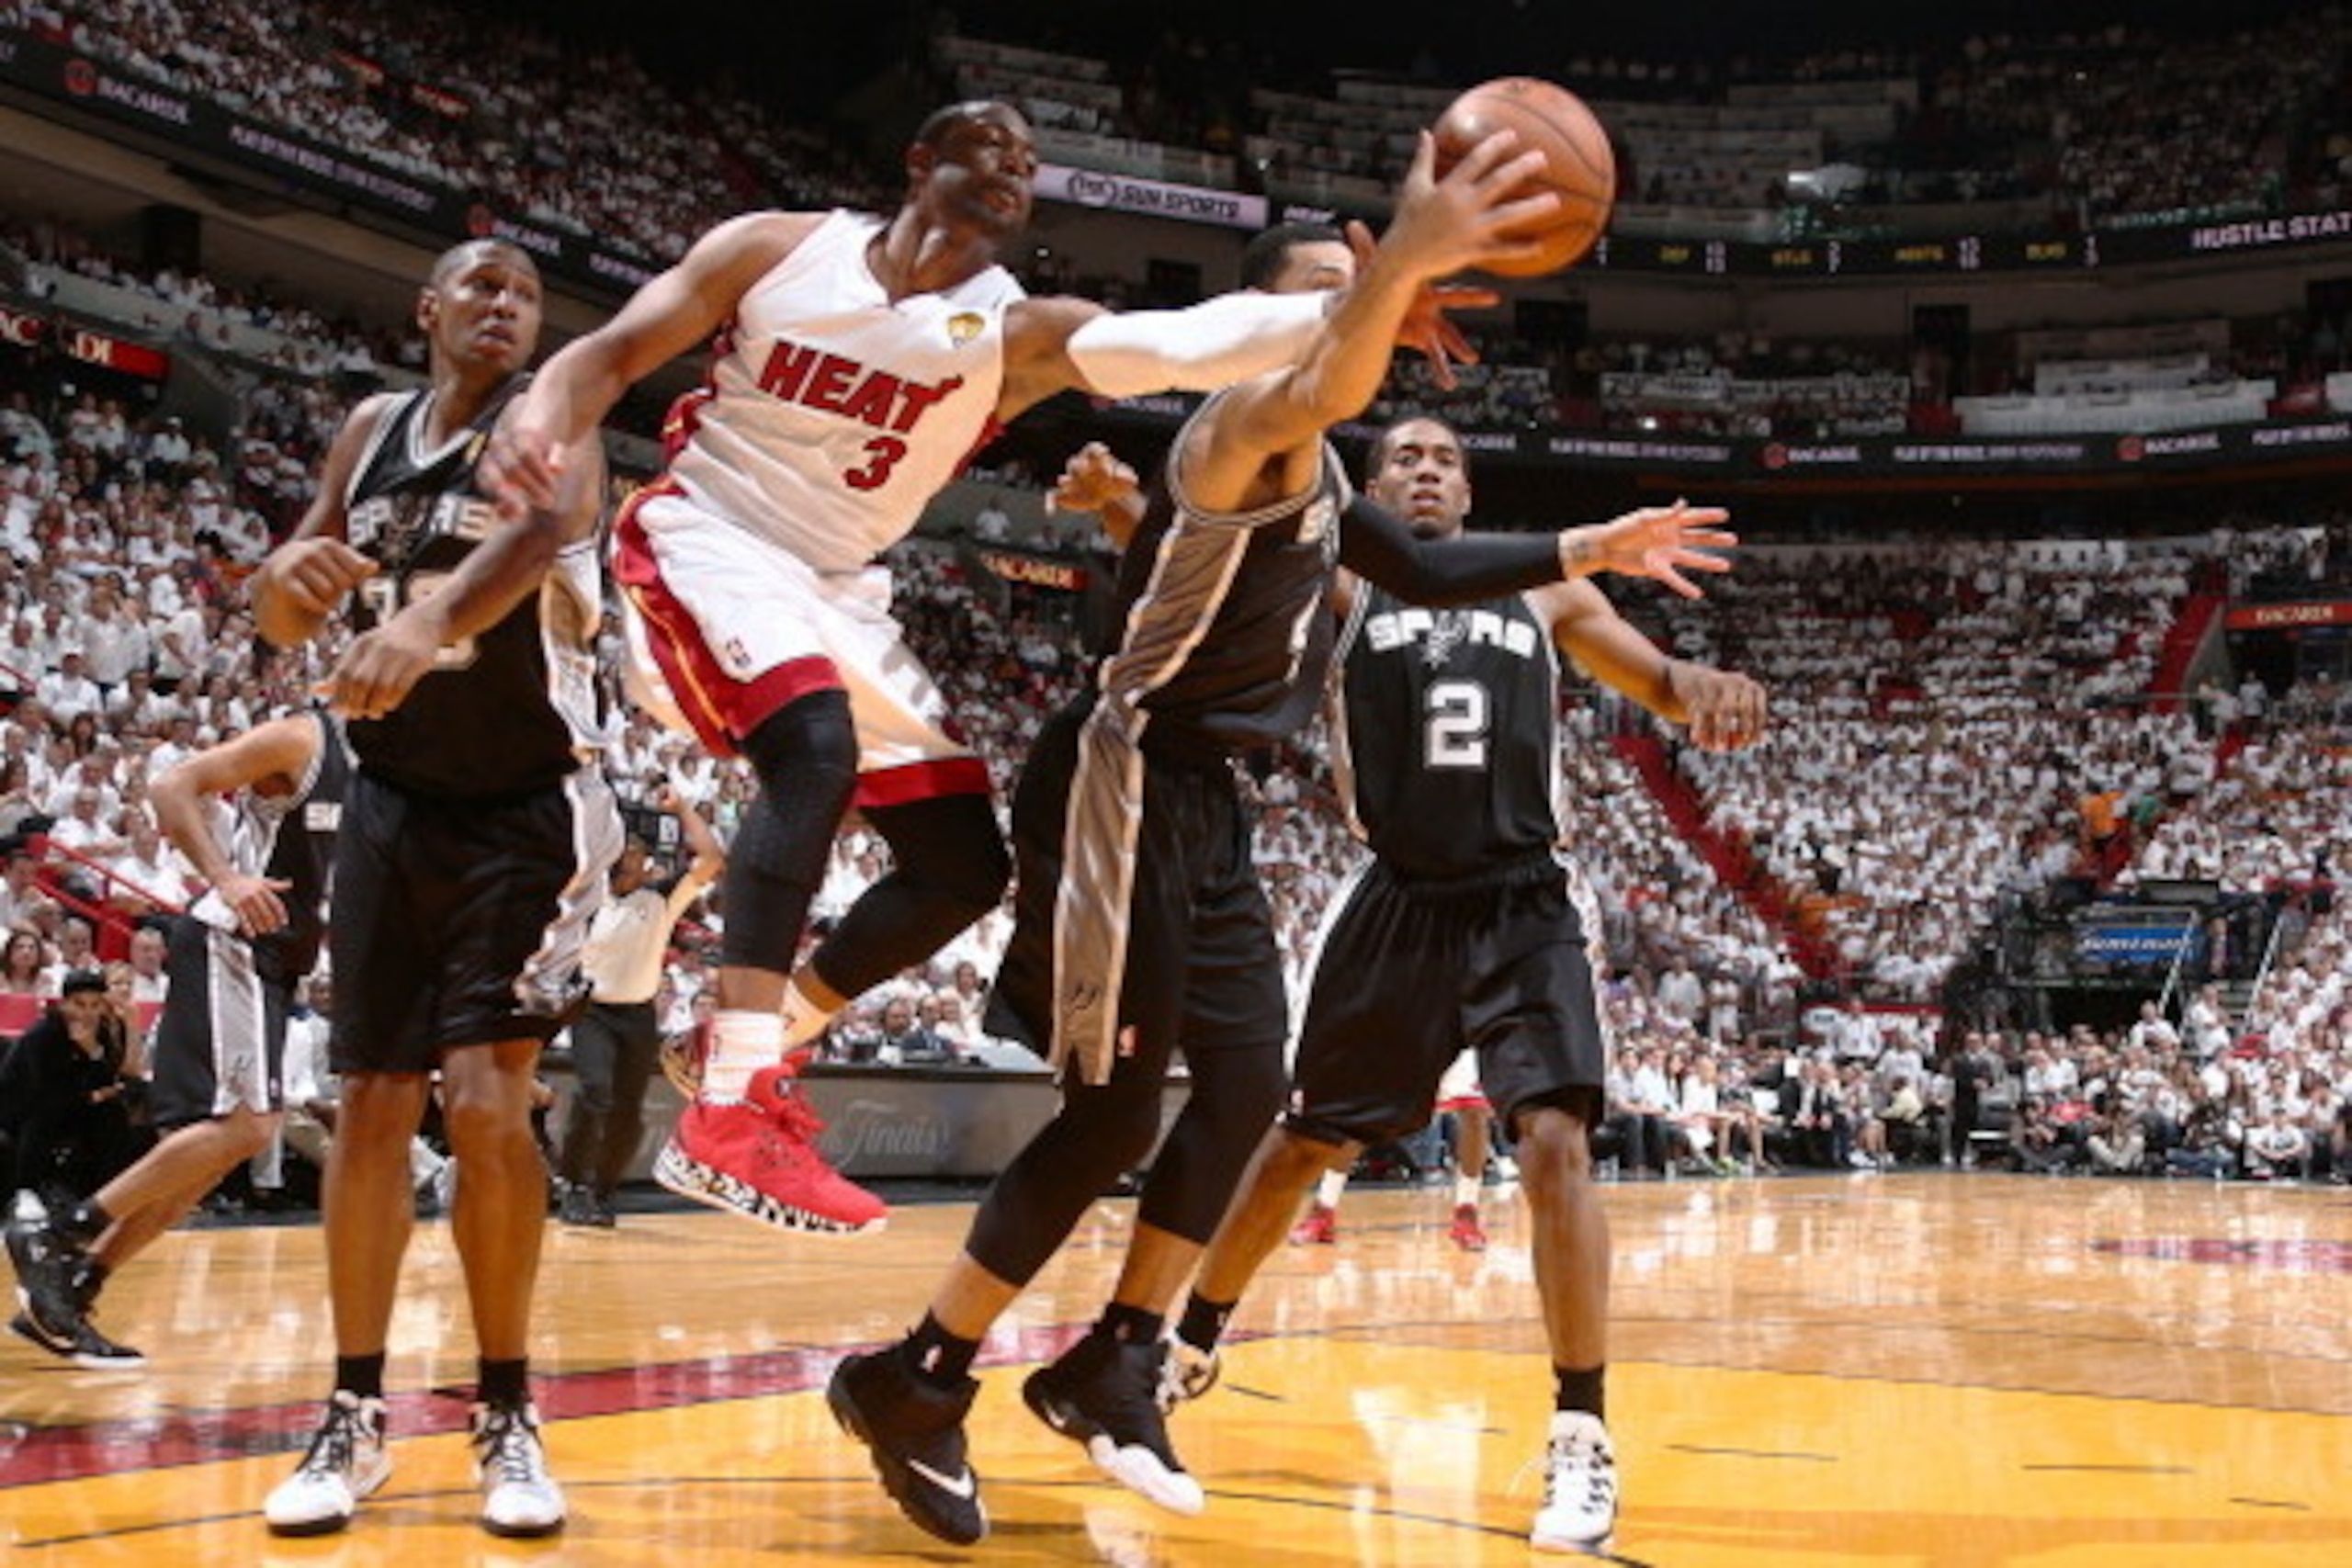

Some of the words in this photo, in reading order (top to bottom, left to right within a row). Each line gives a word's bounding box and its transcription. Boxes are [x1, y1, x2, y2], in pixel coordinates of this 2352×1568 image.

[1122, 184, 1161, 206] SUN
[1165, 190, 1239, 219] SPORTS
[2193, 220, 2285, 249] HUSTLE
[757, 339, 964, 434] HEAT
[843, 435, 907, 491] 3
[1365, 609, 1537, 660] SPURS
[1427, 680, 1490, 769] 2
